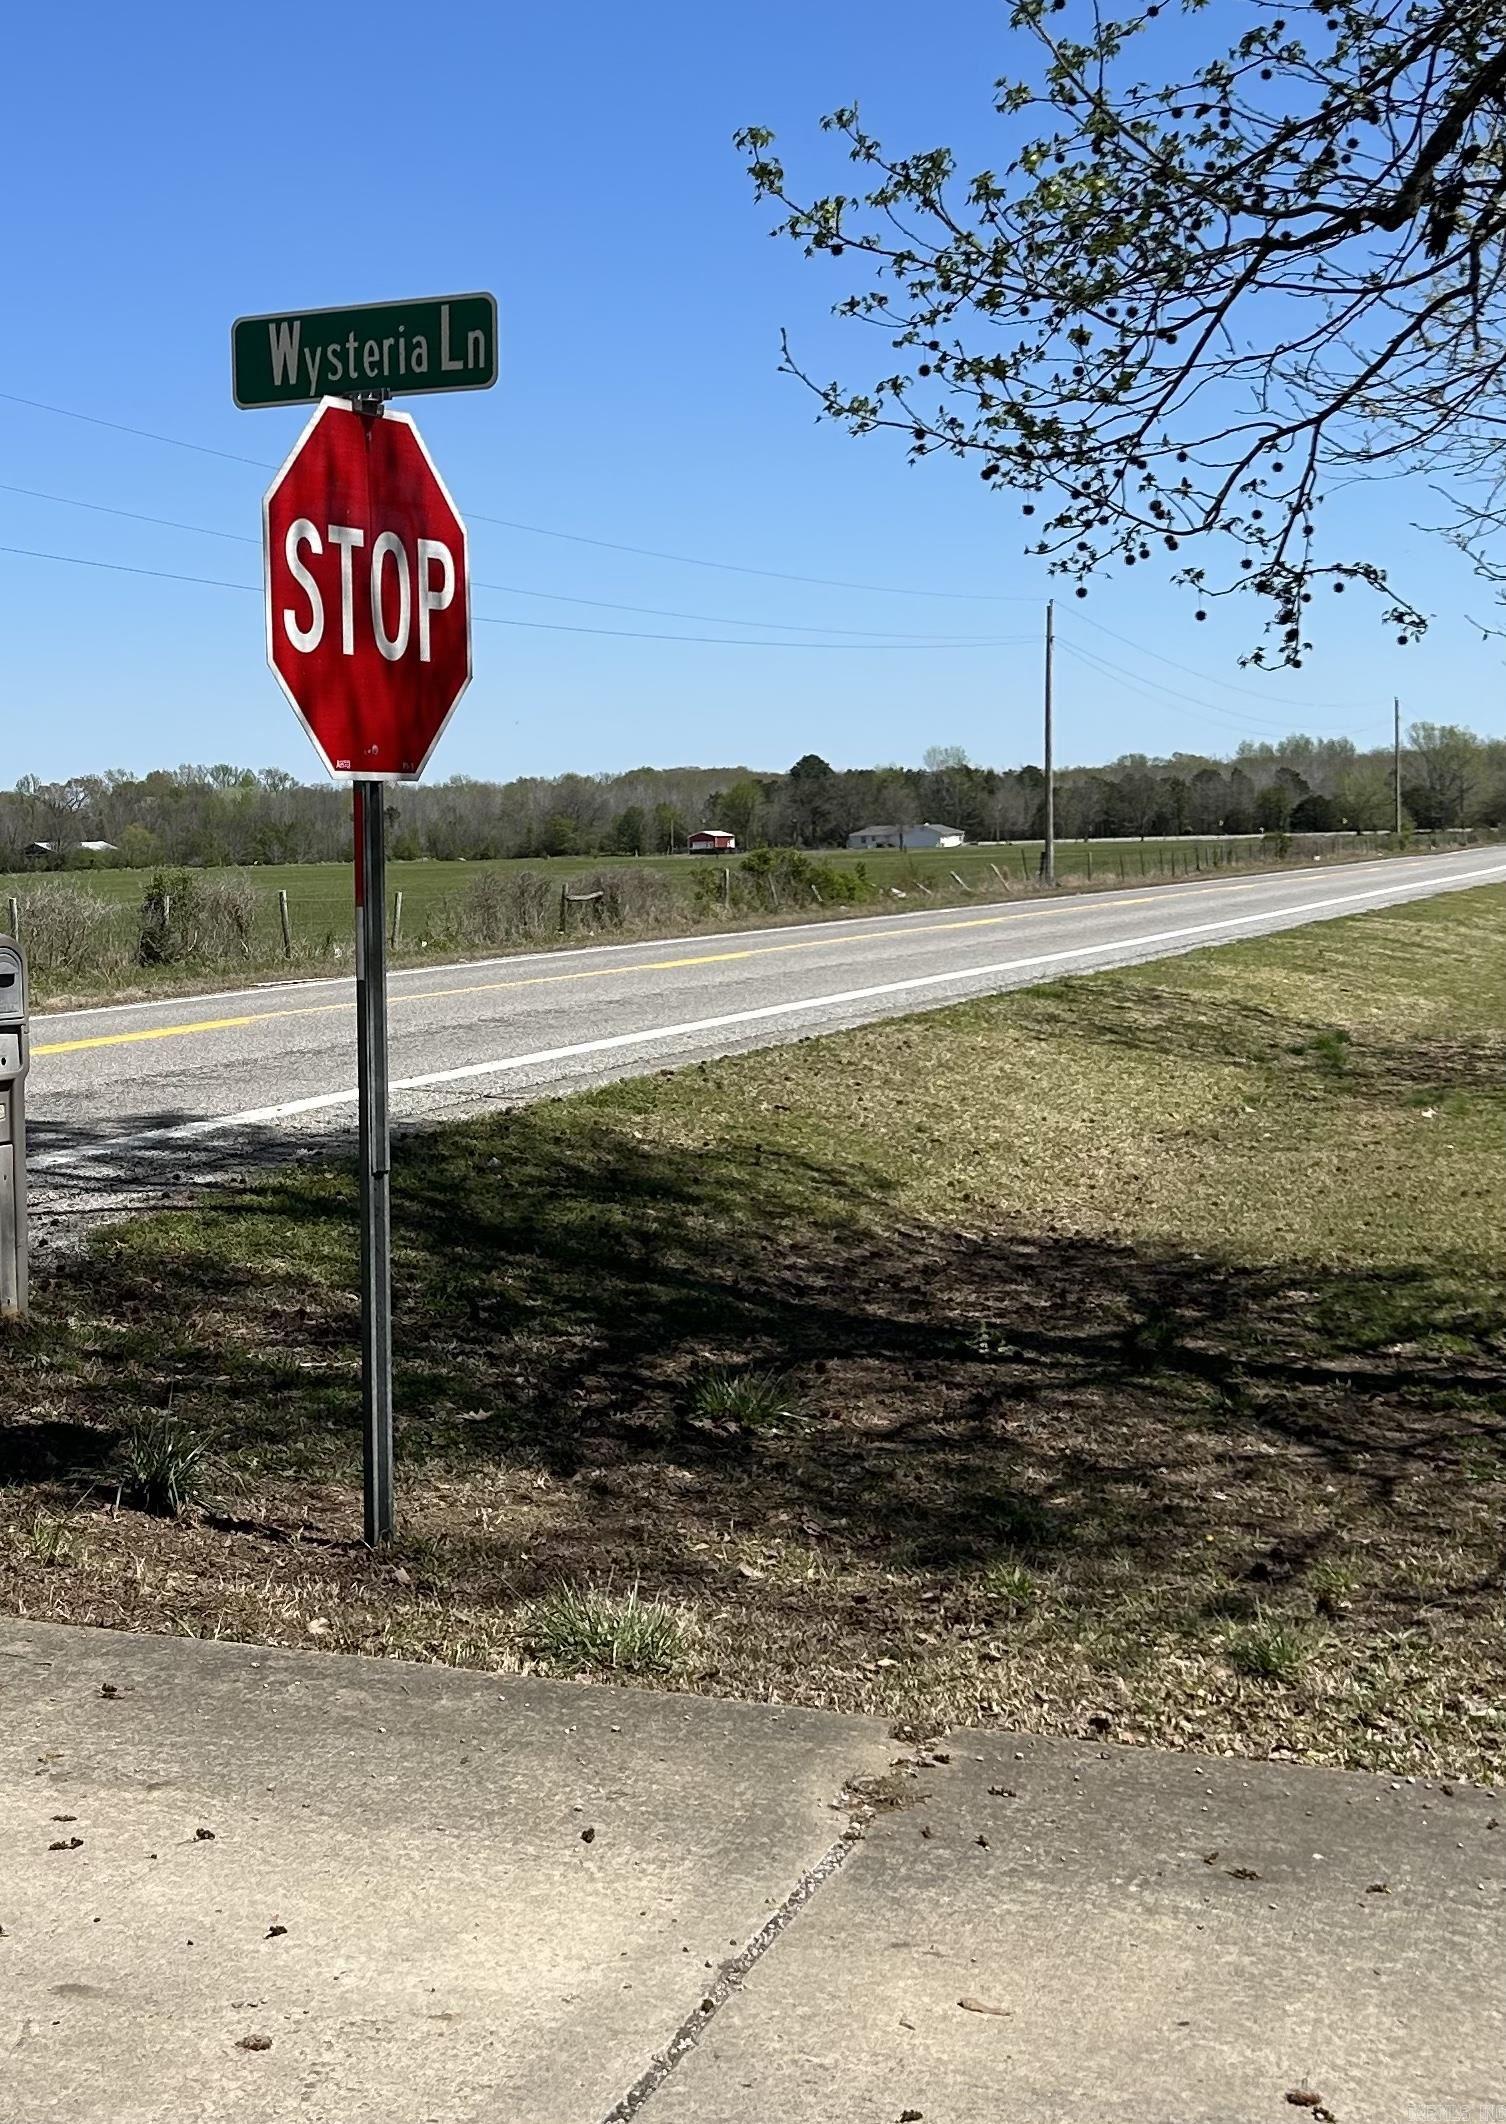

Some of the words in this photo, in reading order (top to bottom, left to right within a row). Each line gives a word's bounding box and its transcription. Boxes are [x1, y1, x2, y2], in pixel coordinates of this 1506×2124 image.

[268, 320, 429, 397] Wysteria
[440, 303, 486, 371] Ln
[283, 517, 456, 662] STOP
